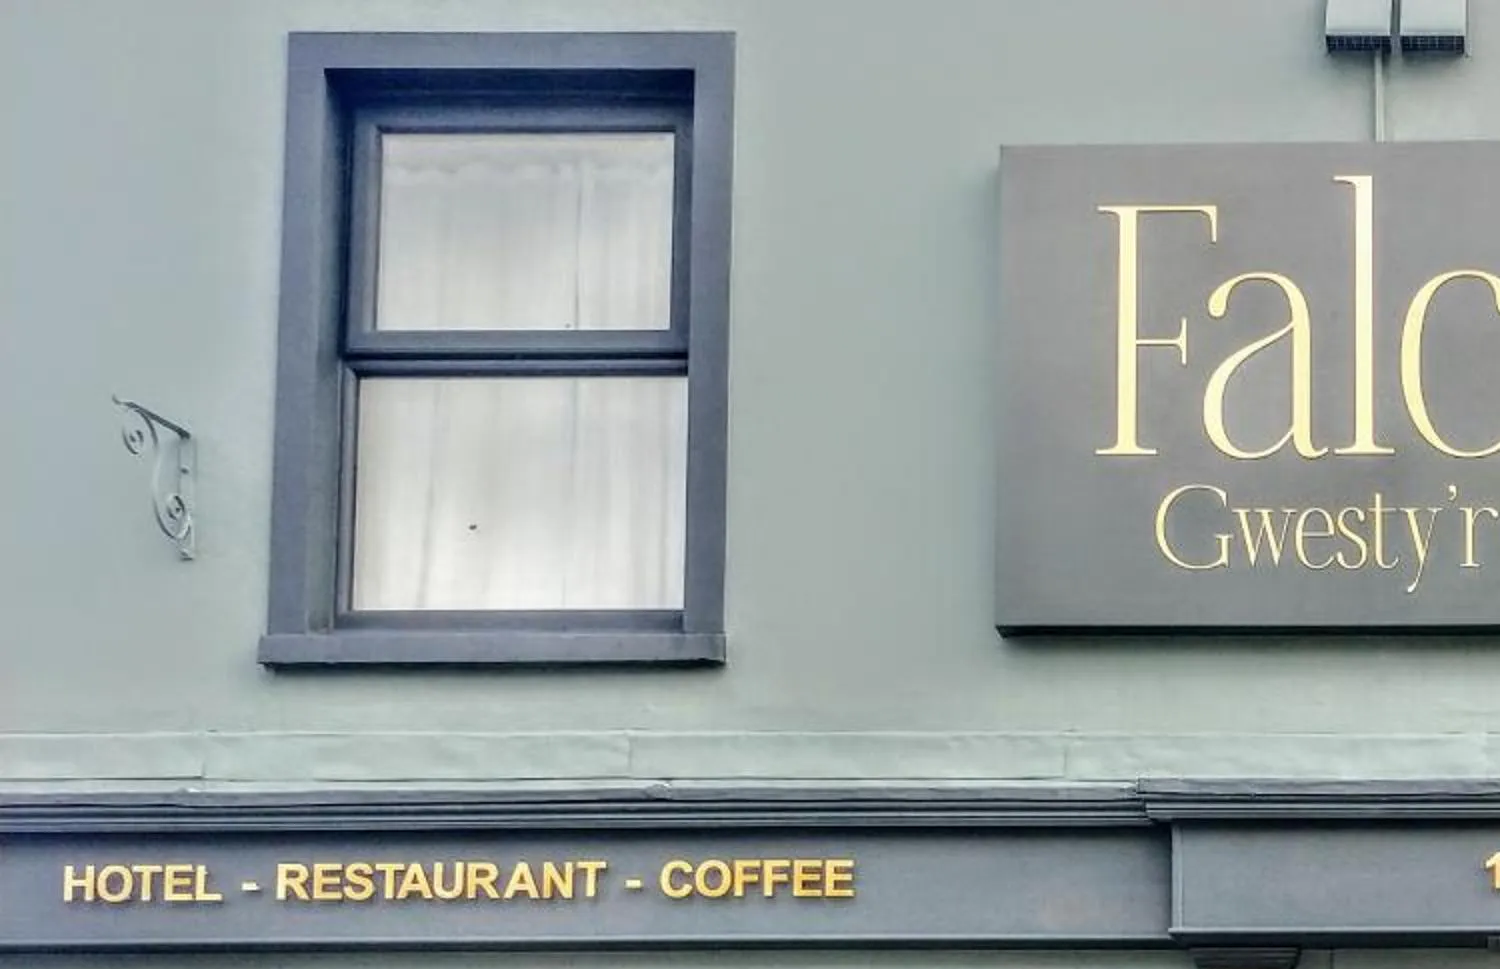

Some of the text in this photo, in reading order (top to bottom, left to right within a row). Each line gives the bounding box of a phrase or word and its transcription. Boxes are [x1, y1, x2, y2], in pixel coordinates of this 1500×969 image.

[1154, 484, 1500, 593] Gwesty'r
[62, 864, 222, 903] HOTEL
[275, 860, 607, 901] RESTAURANT
[659, 858, 856, 899] COFFEE
